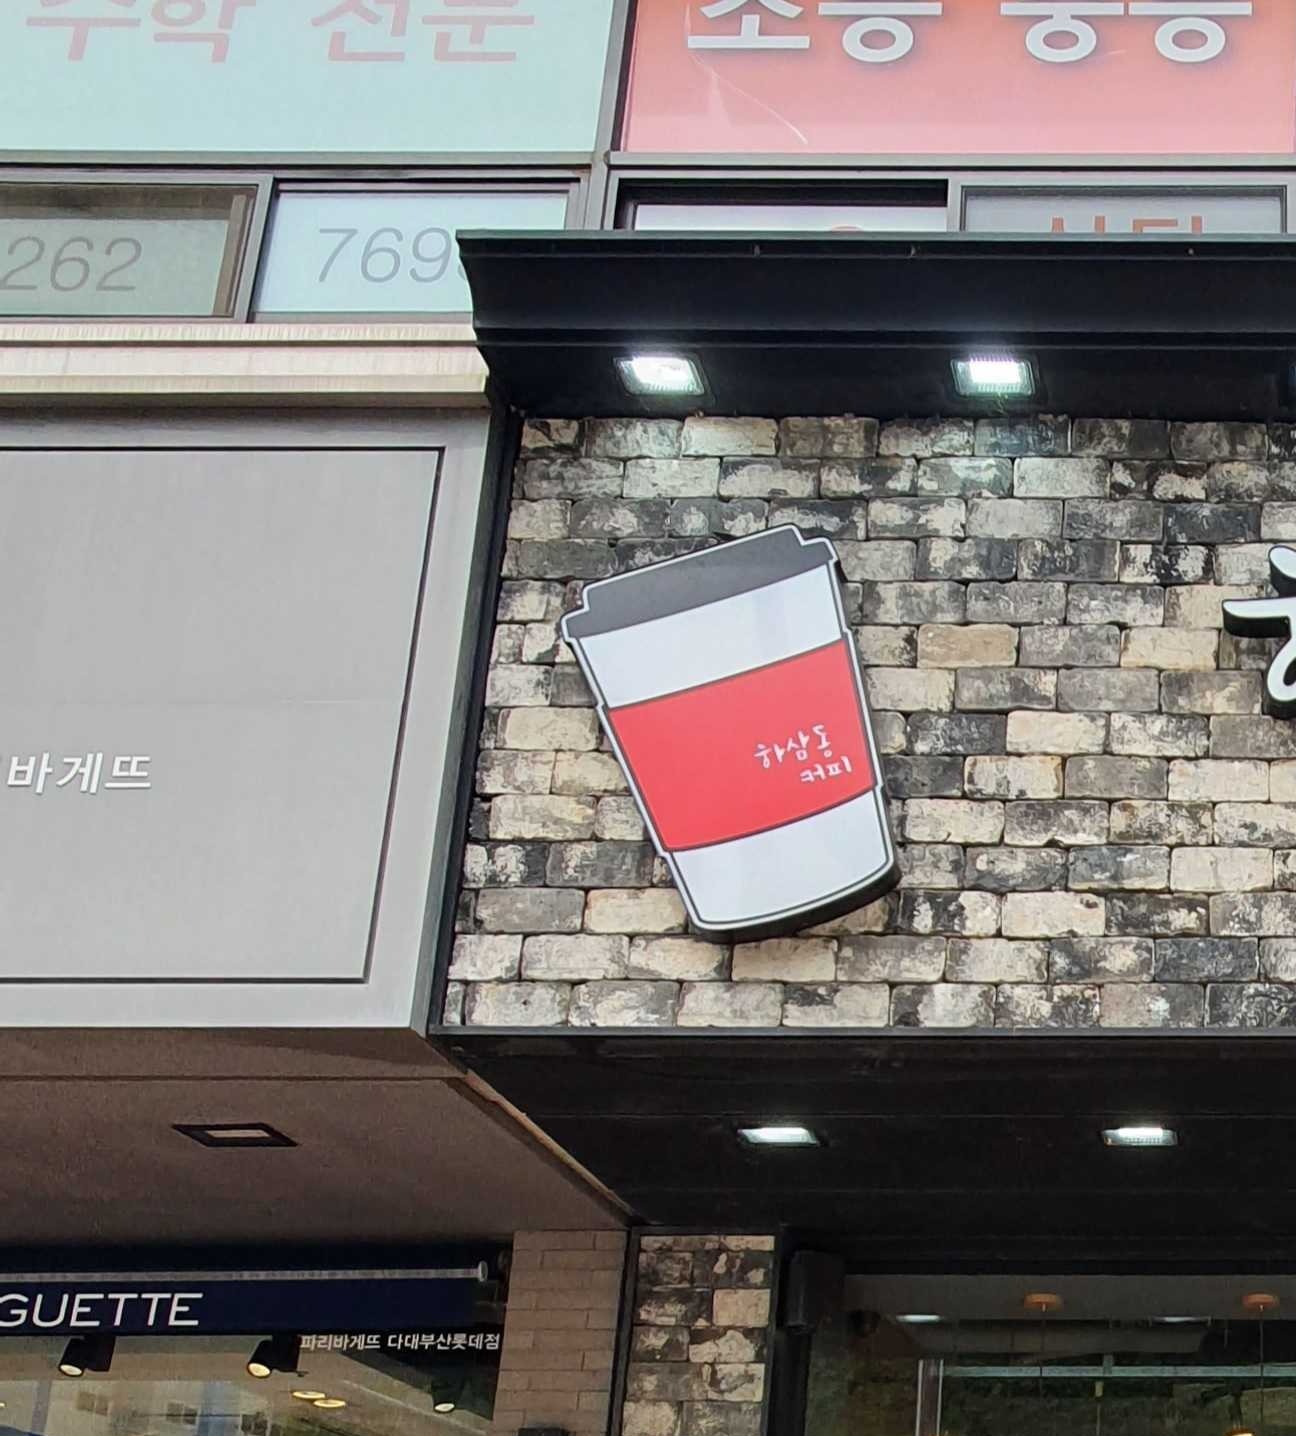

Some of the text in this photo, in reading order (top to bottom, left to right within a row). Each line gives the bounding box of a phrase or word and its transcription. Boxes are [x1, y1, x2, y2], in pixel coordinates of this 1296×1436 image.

[3, 236, 142, 291] 262
[317, 227, 470, 283] 769
[754, 724, 832, 769] 하삼동
[799, 756, 853, 783] 커피
[0, 1293, 203, 1328] GUETTE
[300, 1333, 500, 1350] 파리바게뜨 다대부산롯데점
